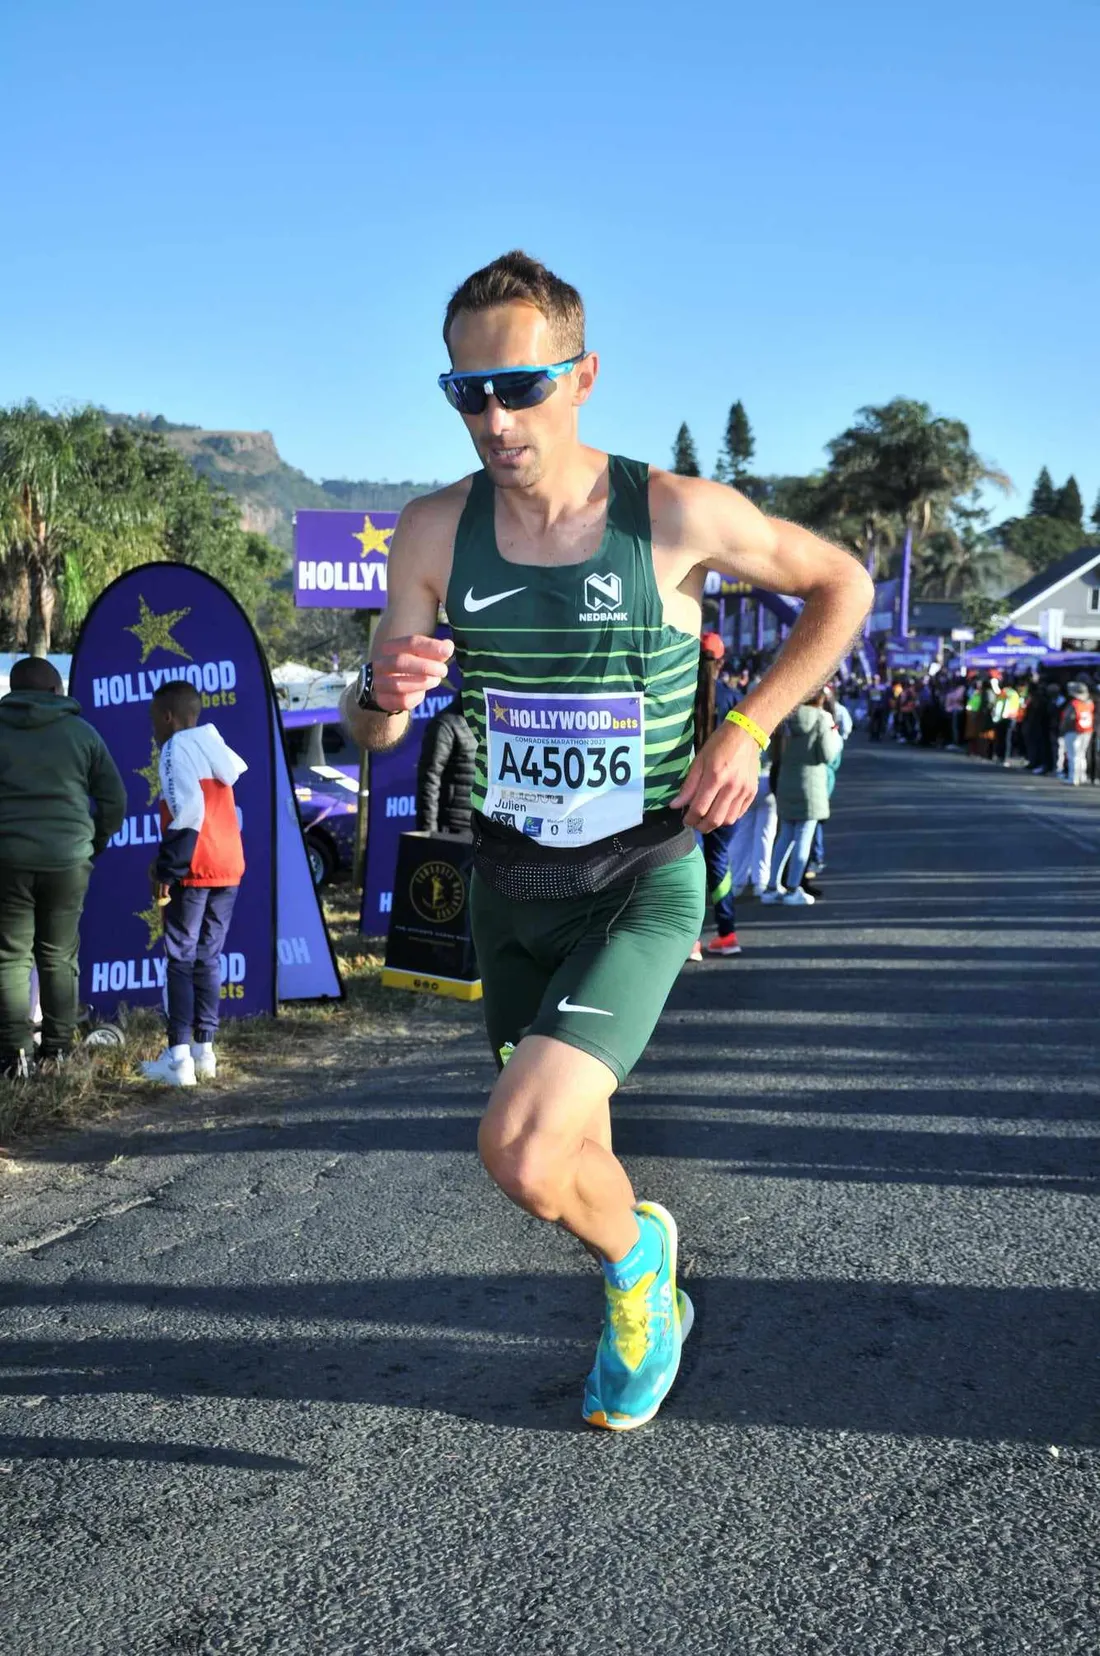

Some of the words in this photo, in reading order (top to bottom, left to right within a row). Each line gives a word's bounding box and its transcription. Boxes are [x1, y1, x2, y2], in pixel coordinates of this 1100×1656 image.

[579, 612, 628, 622] NEDBANK
[201, 691, 236, 708] bets
[515, 736, 549, 745] COMRADES
[551, 738, 589, 746] MARATHON
[498, 741, 631, 790] A45036
[494, 799, 527, 812] Julien
[218, 983, 244, 999] ets
